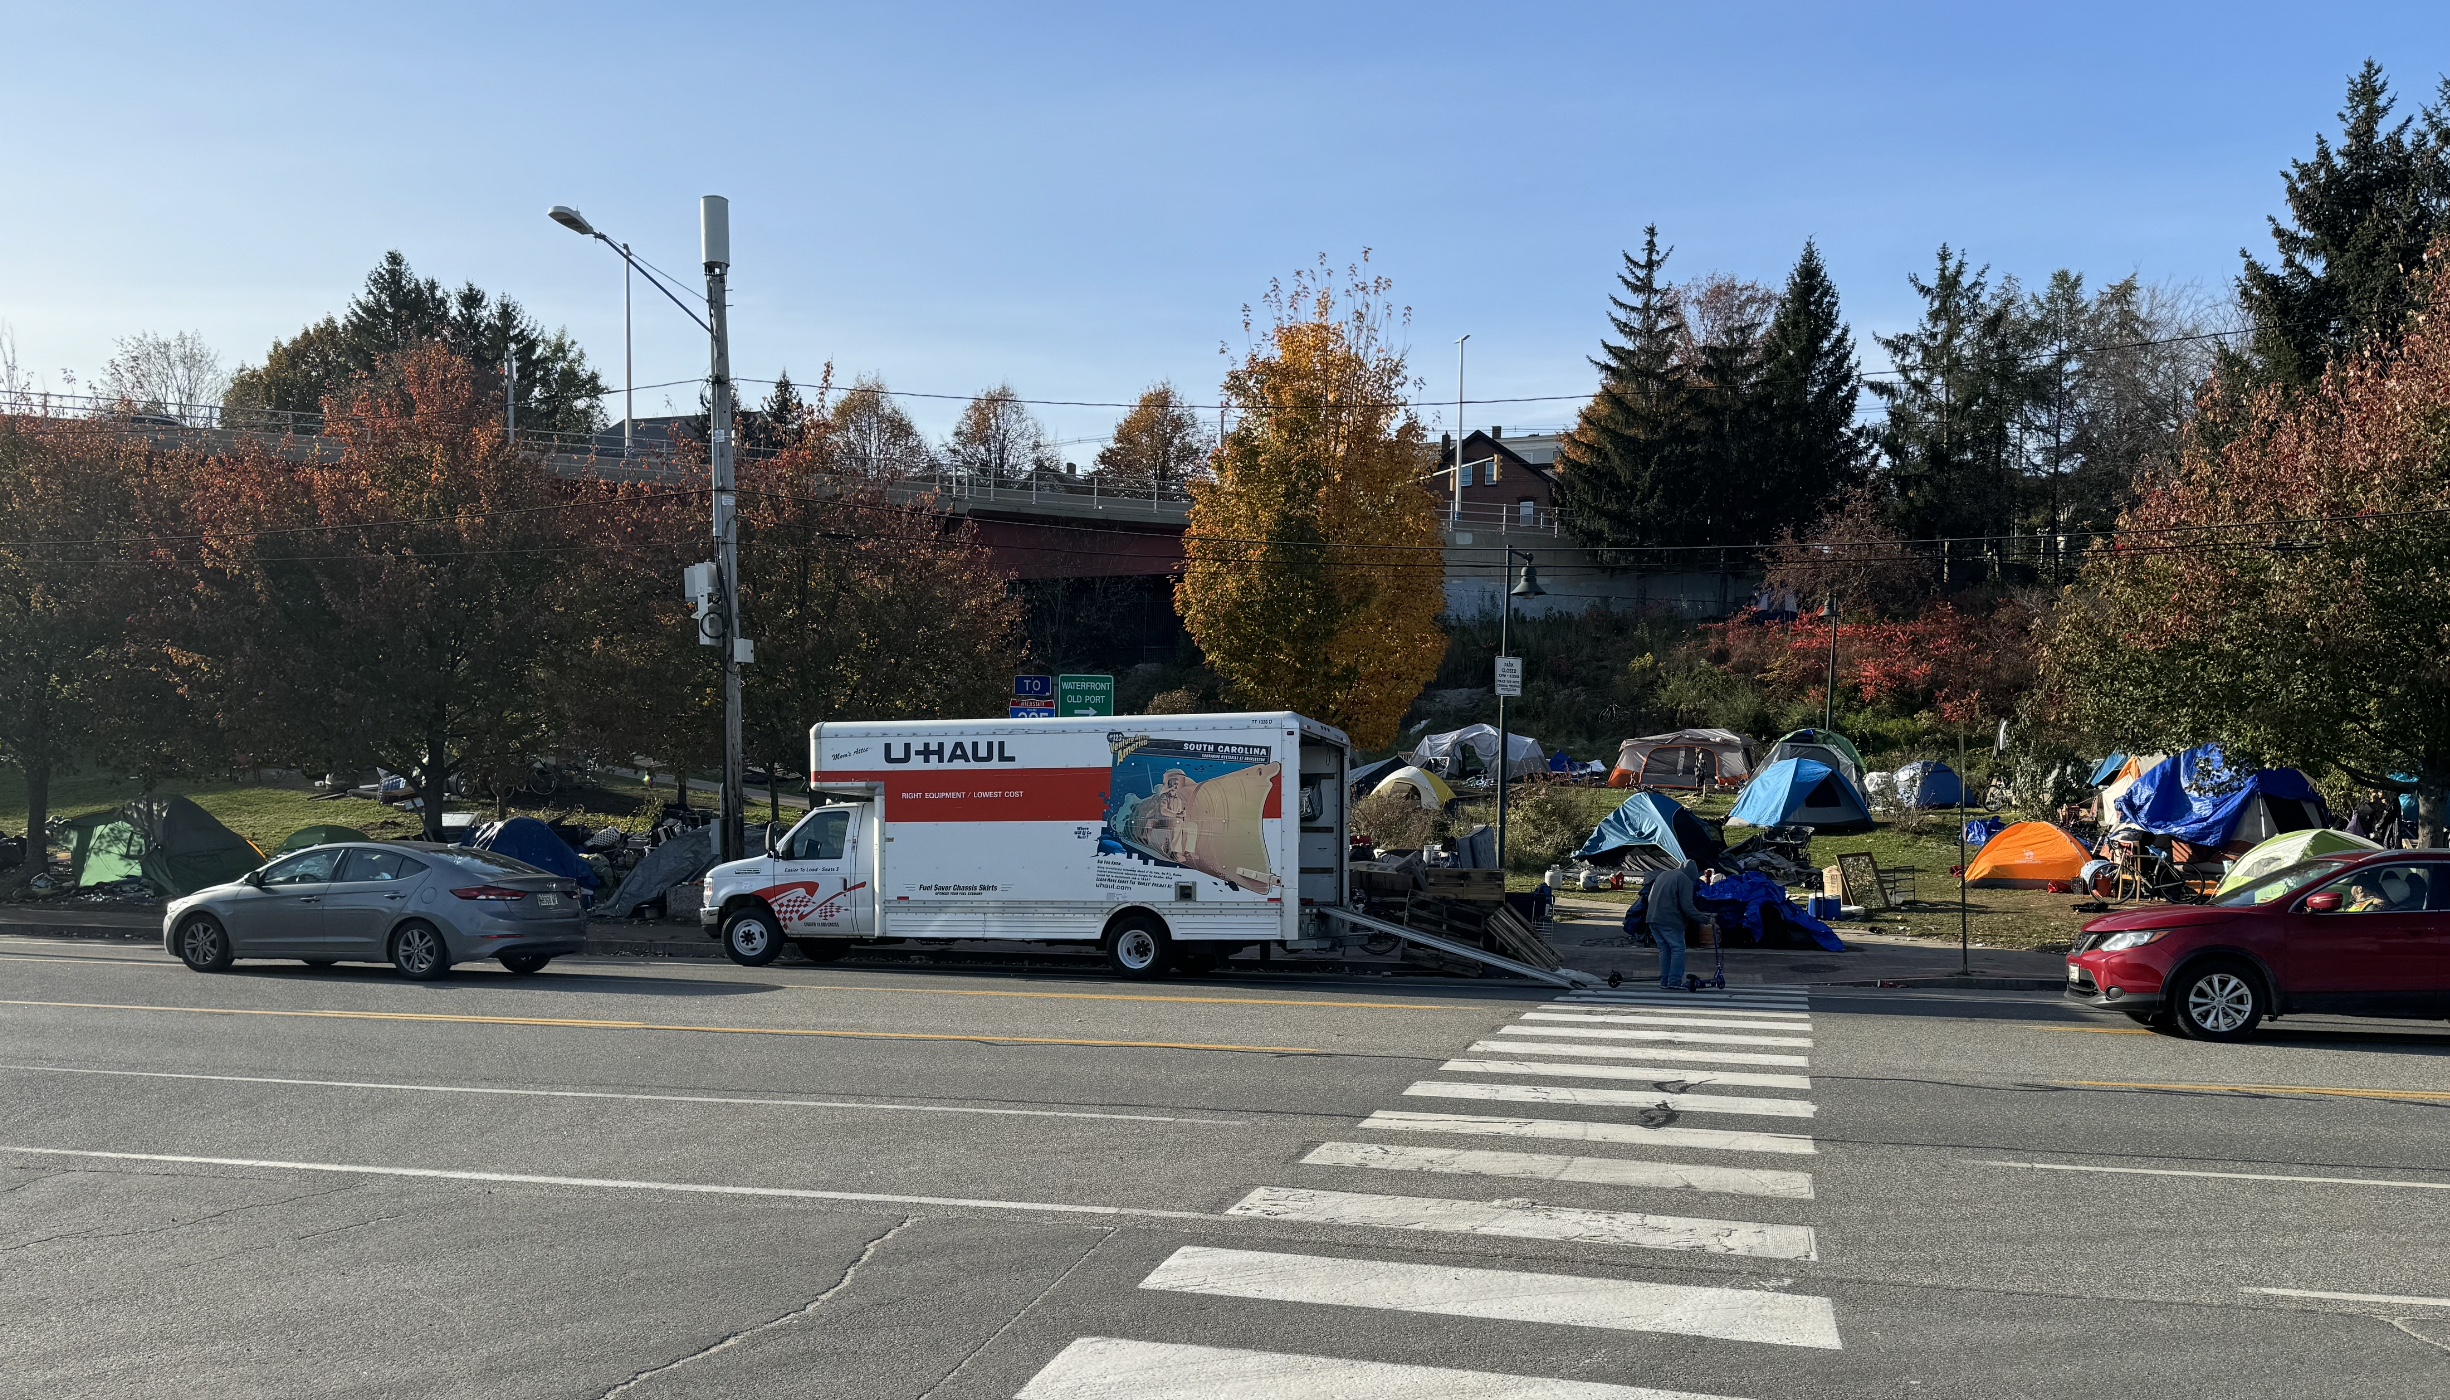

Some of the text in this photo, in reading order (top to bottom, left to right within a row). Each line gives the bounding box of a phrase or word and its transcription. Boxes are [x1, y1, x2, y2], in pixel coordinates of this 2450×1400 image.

[1024, 680, 1040, 691] TO
[1062, 682, 1111, 691] WATERFRONT
[1067, 695, 1105, 703] OLD PORT
[1109, 738, 1134, 753] Venture
[1183, 742, 1267, 756] SOUTH CAROLINA
[1117, 740, 1148, 766] America
